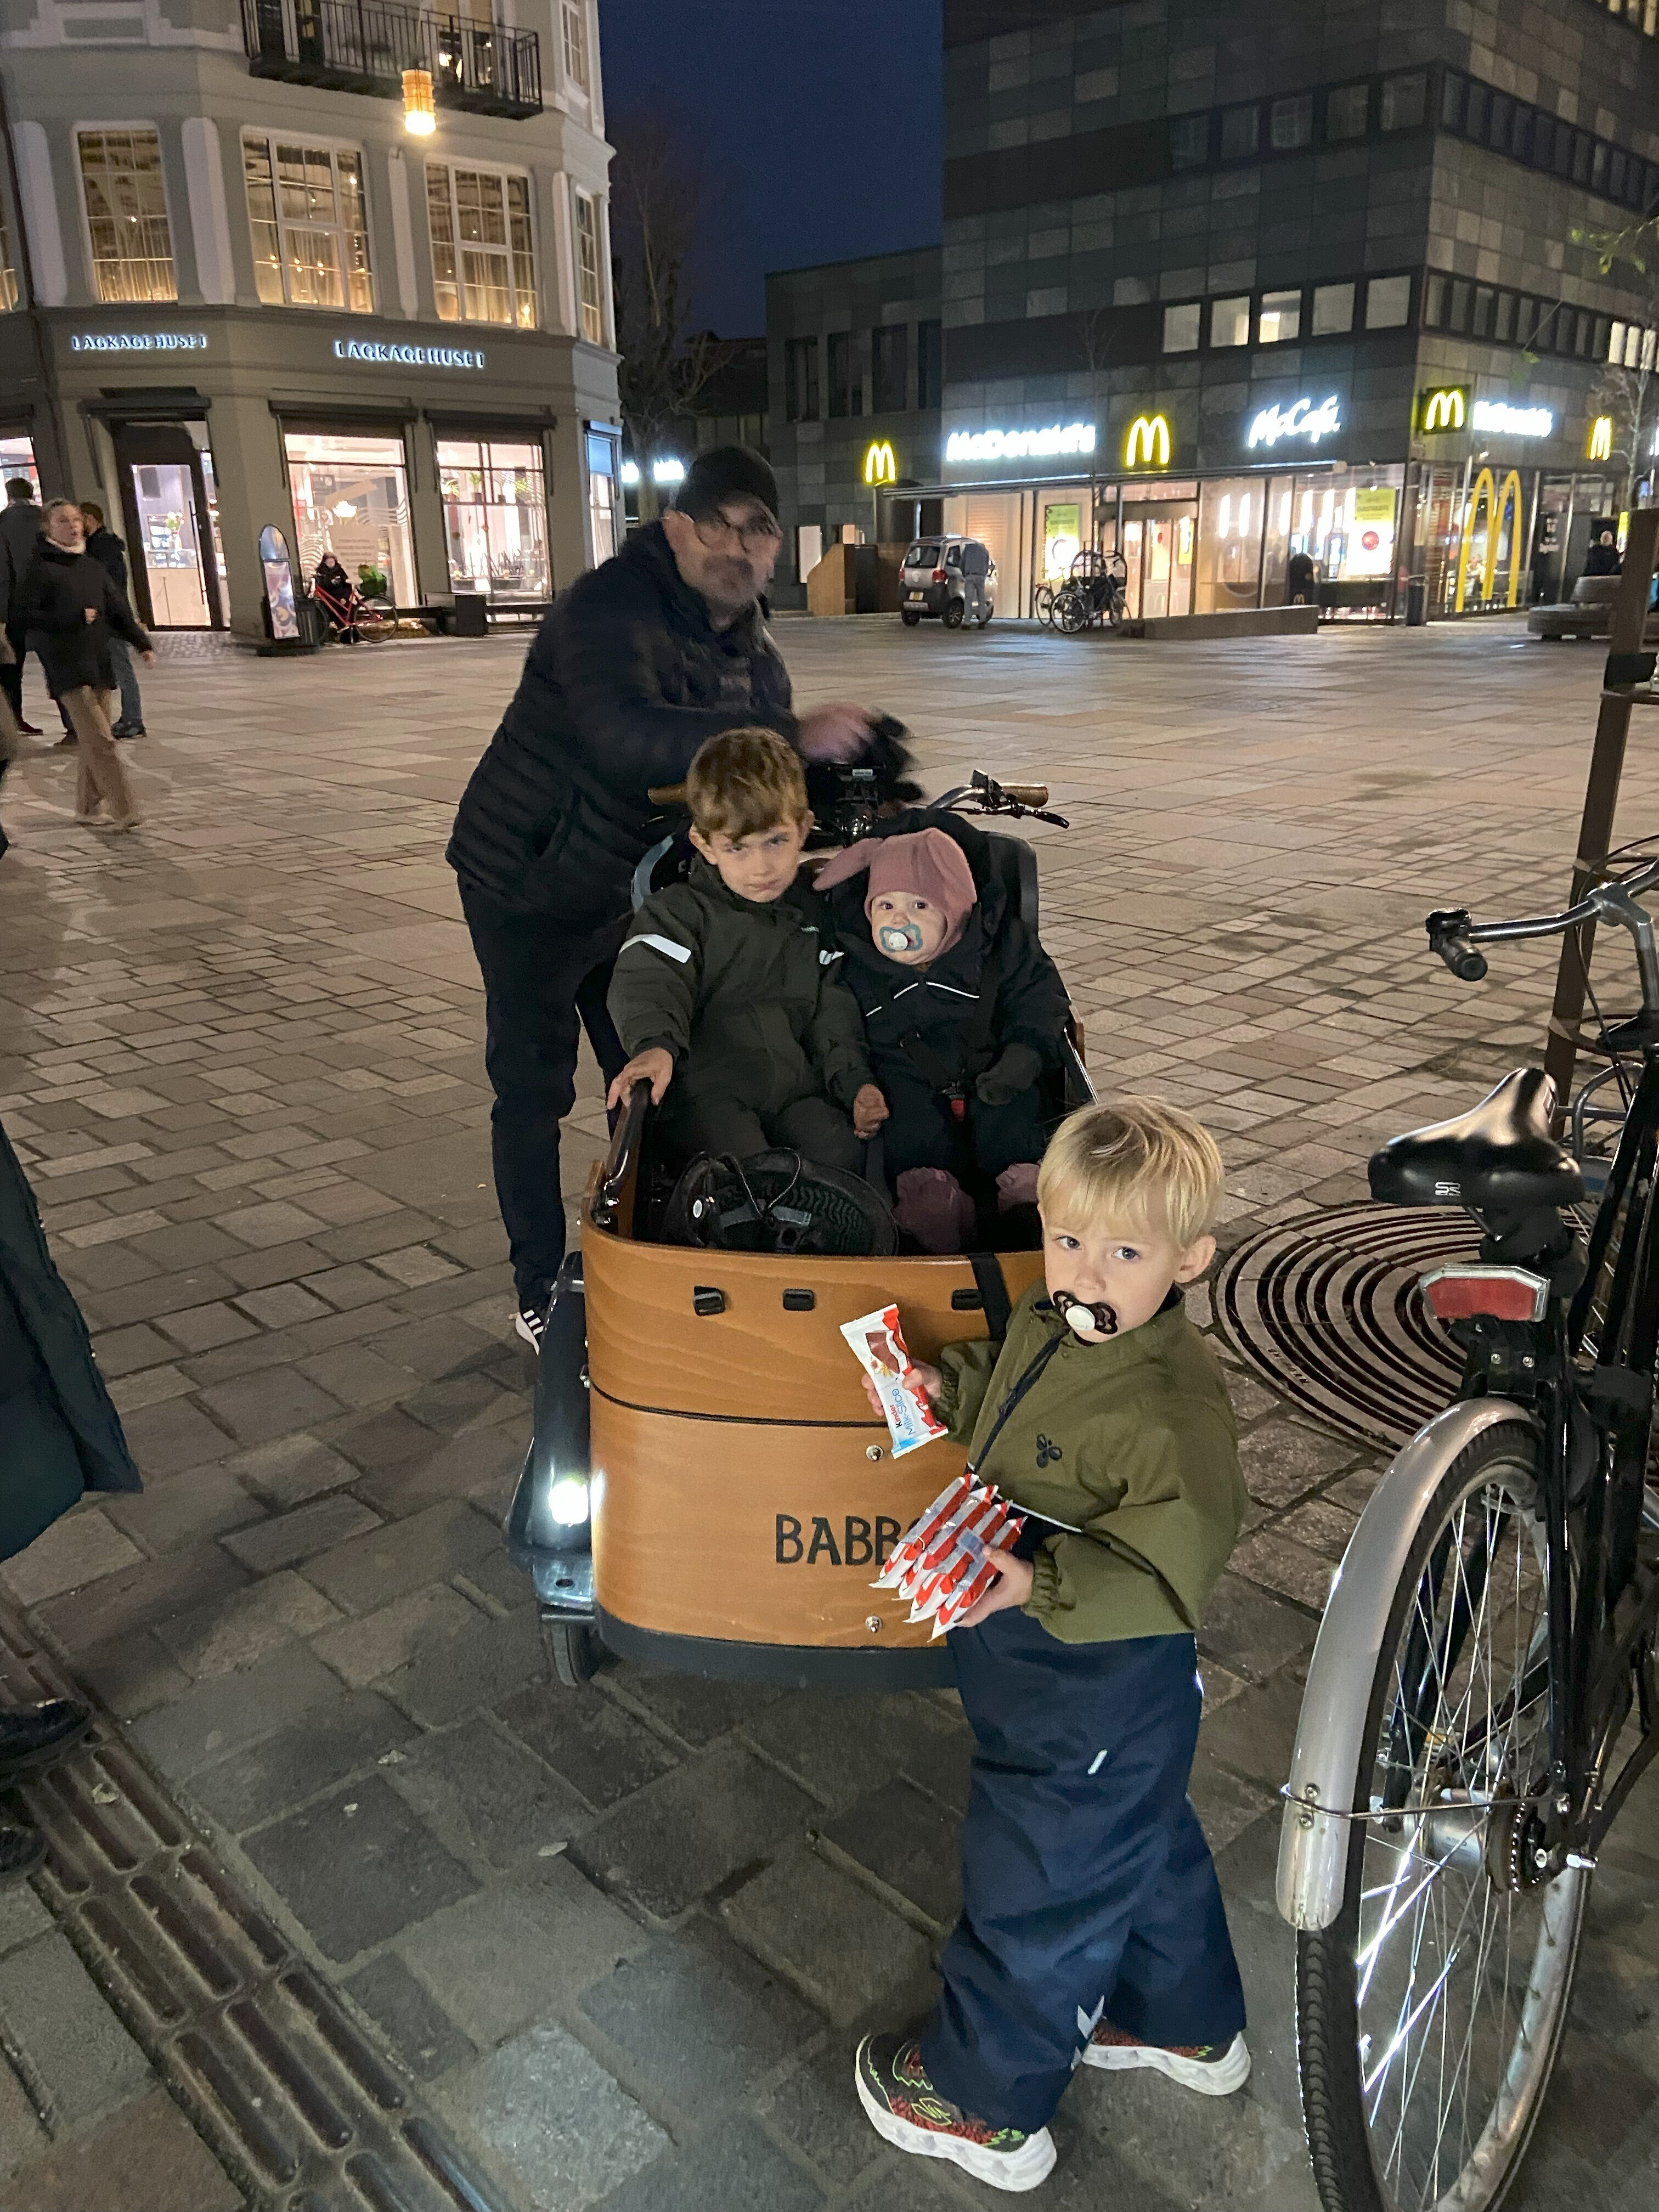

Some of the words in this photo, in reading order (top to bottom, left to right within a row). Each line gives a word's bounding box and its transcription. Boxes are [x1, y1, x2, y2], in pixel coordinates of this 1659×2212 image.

[890, 1404, 902, 1429] Kinder
[892, 1389, 917, 1435] Milk-Slice
[776, 1514, 921, 1566] BABB
